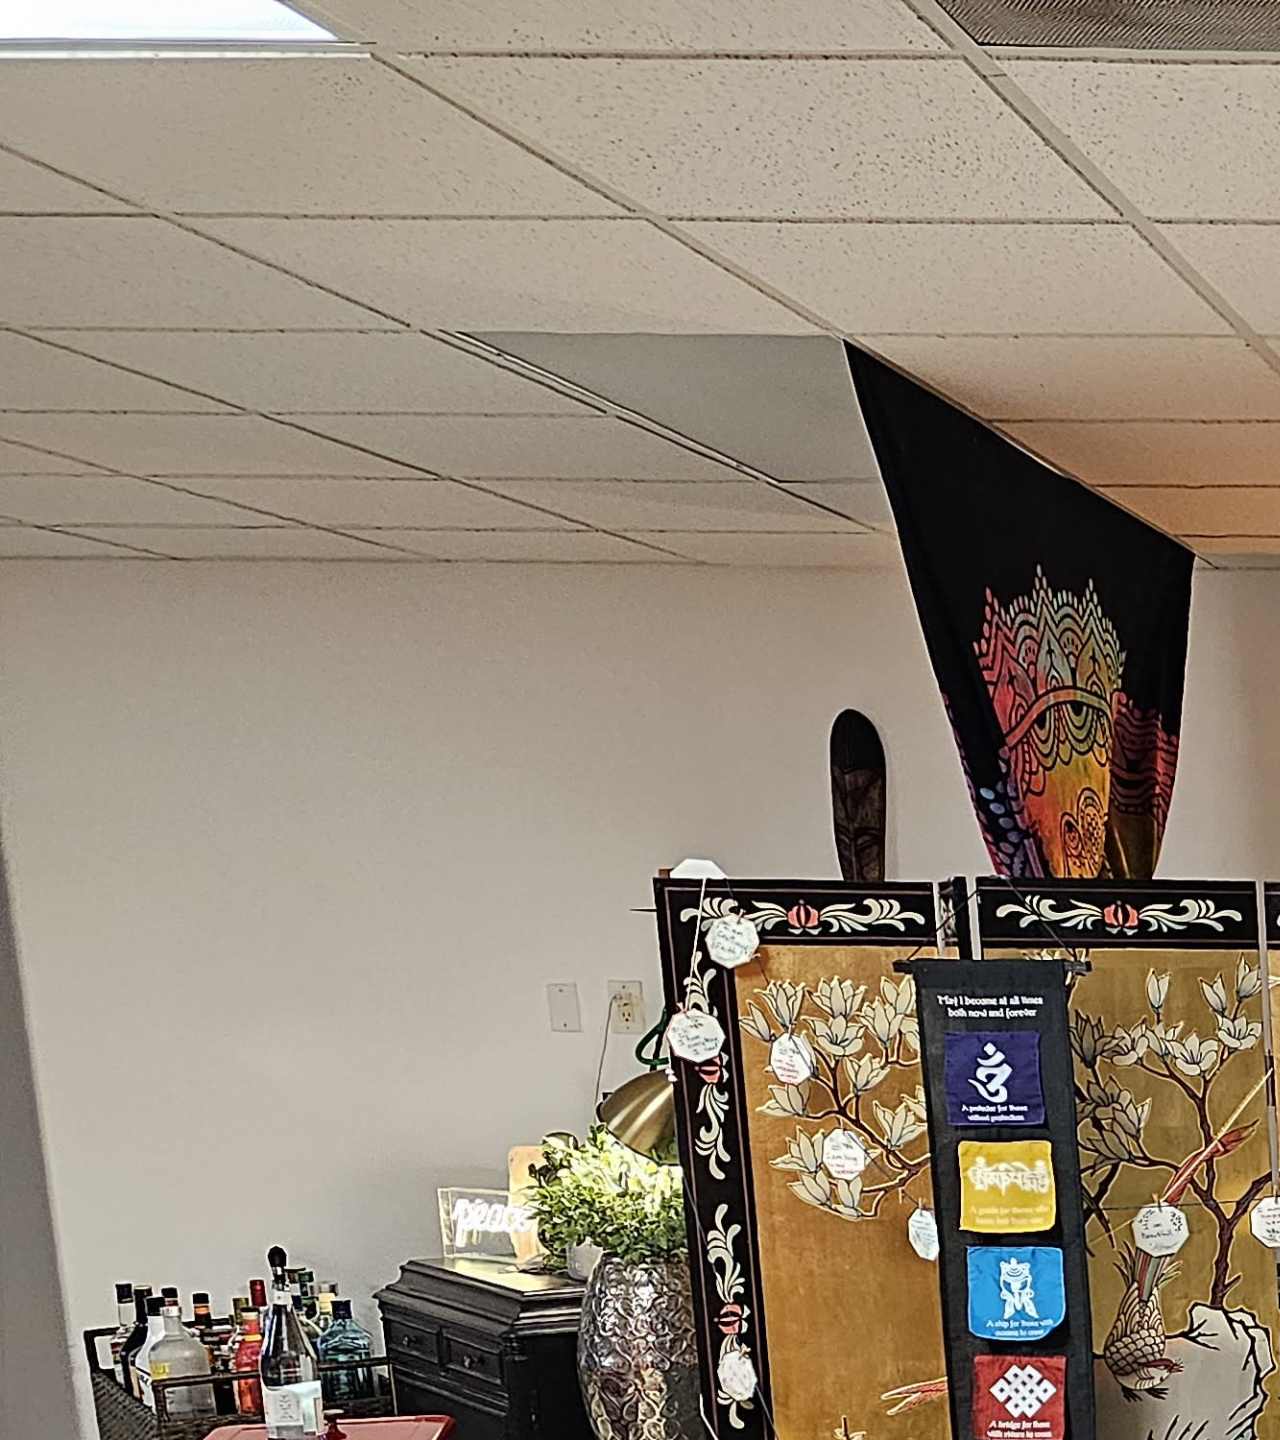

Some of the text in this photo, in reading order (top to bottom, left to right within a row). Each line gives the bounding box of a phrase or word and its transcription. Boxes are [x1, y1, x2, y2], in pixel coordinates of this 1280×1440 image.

[937, 995, 958, 1007] May
[964, 996, 998, 1006] become
[1009, 995, 1020, 1005] all
[947, 1007, 968, 1017] both
[988, 1007, 1005, 1018] and
[1005, 1007, 1037, 1019] forever
